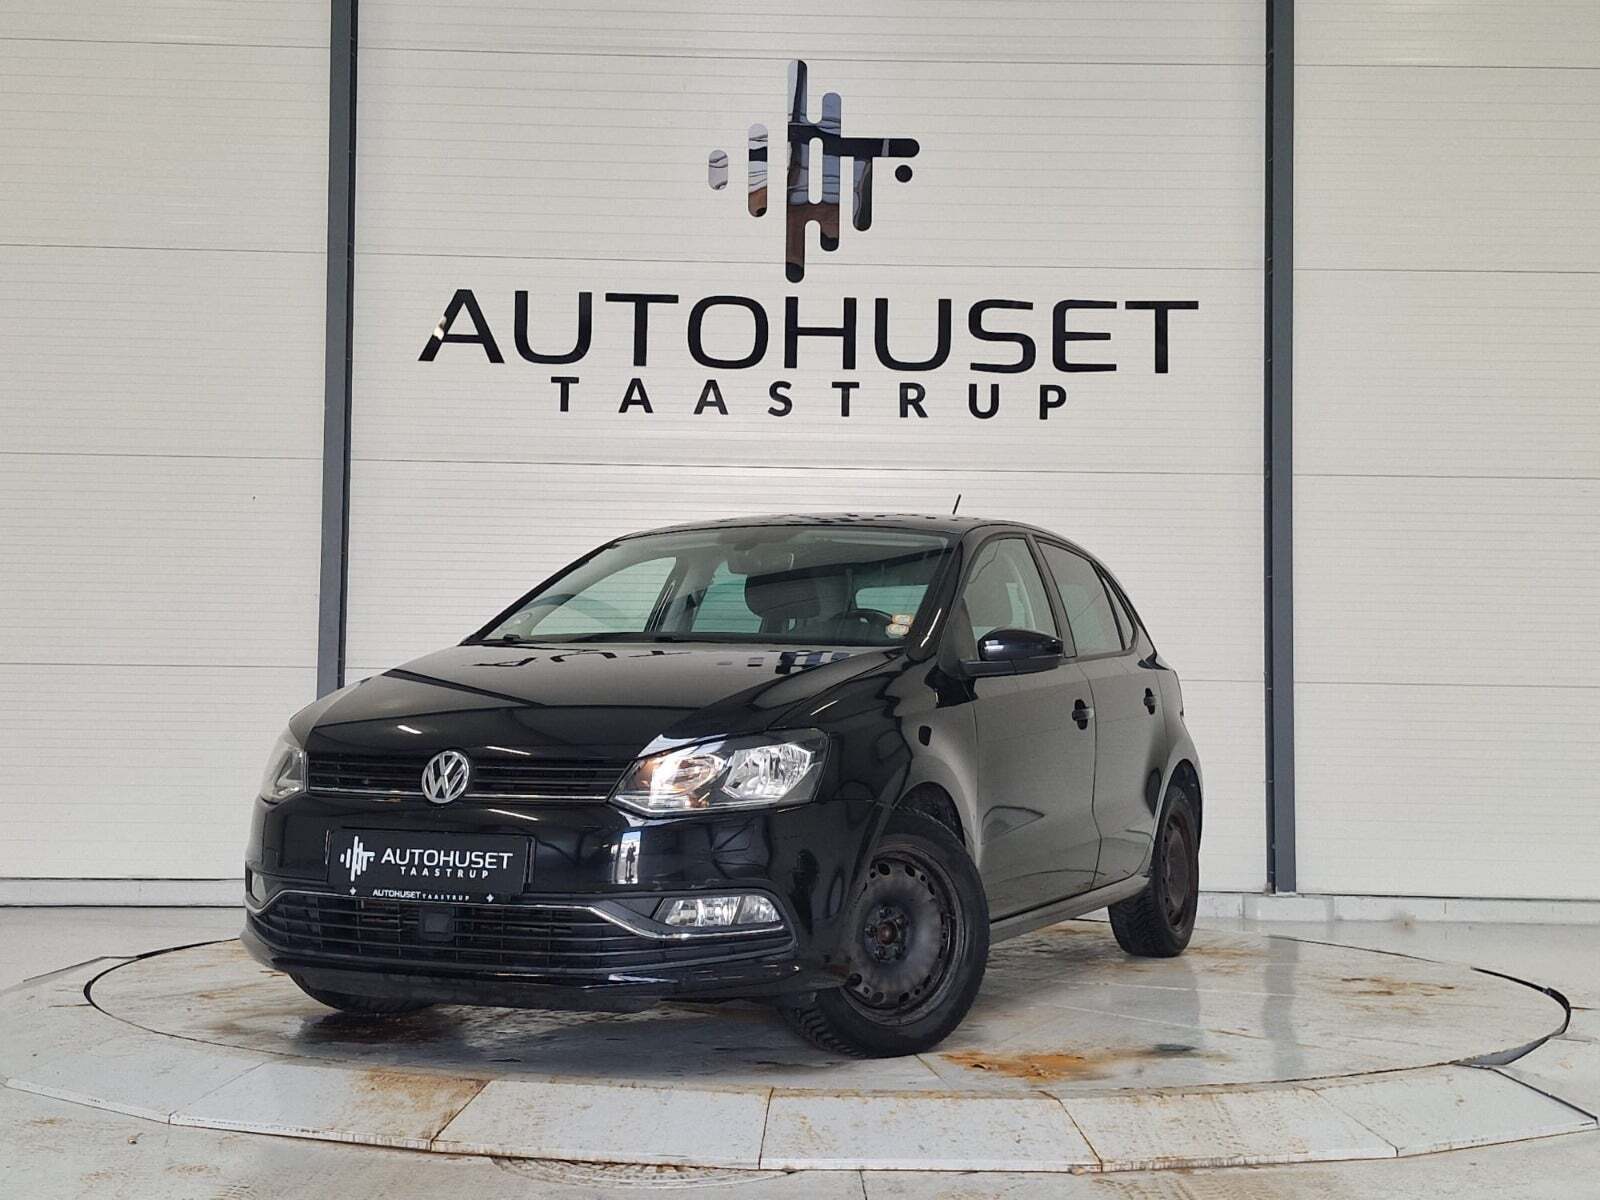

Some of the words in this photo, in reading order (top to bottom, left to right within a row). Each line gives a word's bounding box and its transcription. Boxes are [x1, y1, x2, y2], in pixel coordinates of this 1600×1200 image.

[418, 288, 1199, 374] AUTOHUSET
[550, 376, 1067, 420] TAASTRUP
[381, 847, 513, 869] AUTOHUSET
[400, 866, 489, 879] TAASTRUP
[372, 889, 421, 899] AUTOHUSET
